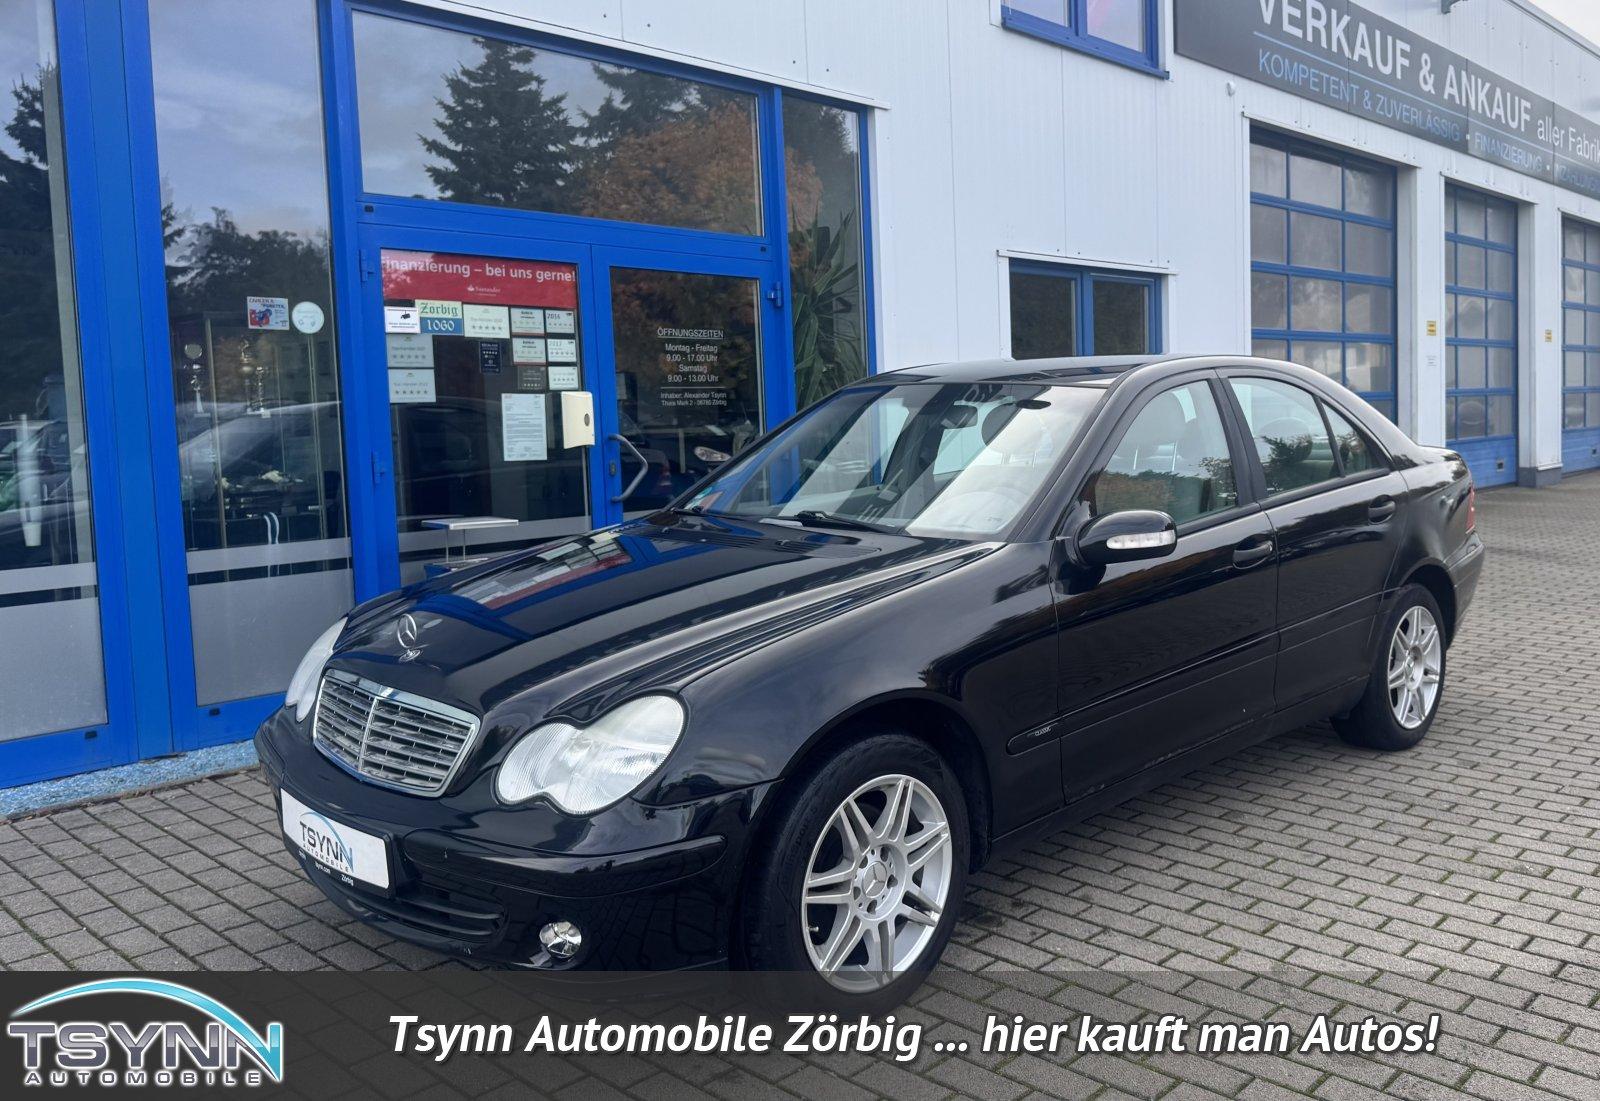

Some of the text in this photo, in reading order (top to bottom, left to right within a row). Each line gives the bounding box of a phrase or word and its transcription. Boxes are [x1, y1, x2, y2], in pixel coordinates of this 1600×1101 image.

[1259, 0, 1411, 80] VERKAUF
[1419, 53, 1436, 95] &
[1443, 64, 1532, 132] ANKAUF
[1537, 116, 1565, 148] aller
[1258, 48, 1543, 172] KOMPETENT & ZUVERLÄSSIG FINANZIERUNG
[485, 263, 506, 277] bei
[510, 268, 532, 280] uns
[536, 270, 576, 283] gerne!
[657, 326, 724, 338] ÖFFNUNGSZEITEN
[665, 343, 690, 353] Montag
[695, 344, 718, 353] Freitag
[666, 354, 681, 362] 9.00
[706, 354, 718, 362] Uhr
[678, 364, 708, 373] Samstag
[667, 374, 682, 382] 9.00
[688, 374, 706, 382] 13.00
[707, 374, 719, 382] Uhr
[299, 820, 354, 873] TSYNN
[303, 843, 349, 873] AUTOMOBILE
